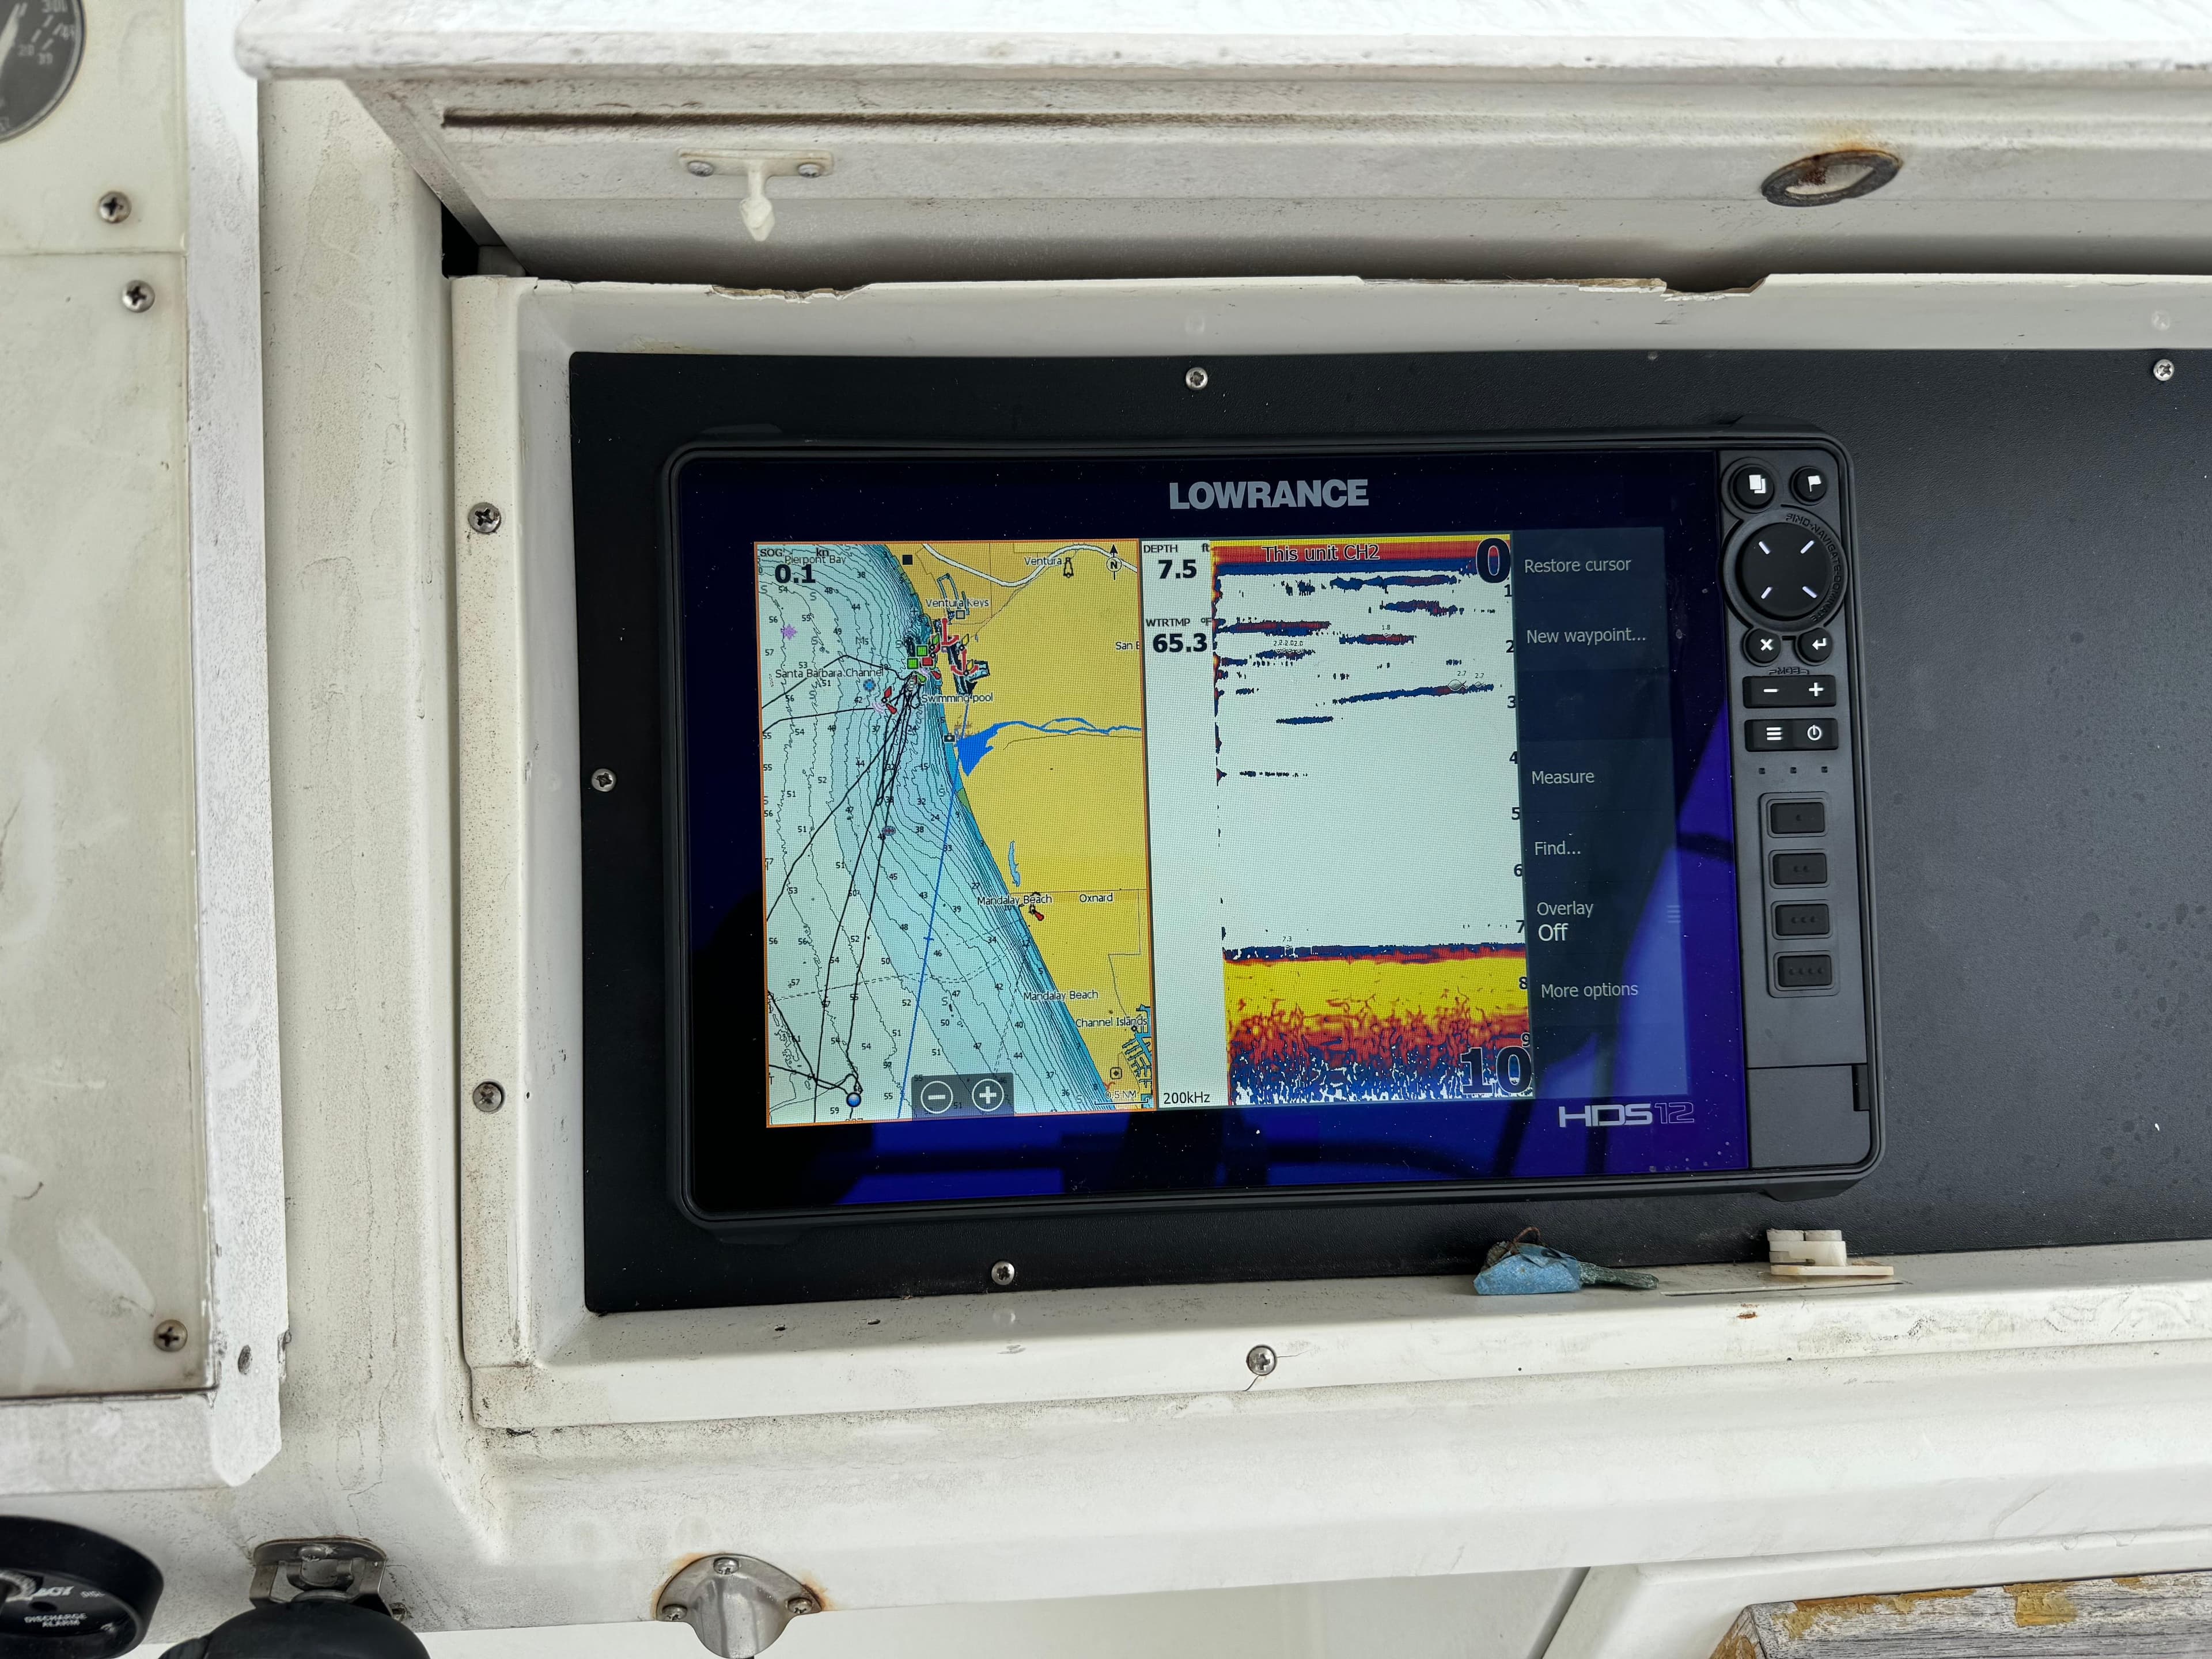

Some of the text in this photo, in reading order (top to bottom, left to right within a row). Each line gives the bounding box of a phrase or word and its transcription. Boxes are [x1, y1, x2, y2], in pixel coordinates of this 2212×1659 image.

[1169, 479, 1369, 509] LOWRANCE
[760, 548, 830, 557] SOG kn
[1143, 543, 1210, 553] DEPTH ft
[1262, 544, 1380, 563] This unit CH2
[785, 555, 846, 565] Pierpont Bay
[1024, 556, 1062, 565] Ventura
[1111, 561, 1118, 569] N
[1476, 537, 1511, 584] 0
[1524, 559, 1631, 573] Restore cursor
[775, 564, 816, 584] 0.1
[1158, 559, 1197, 579] 7.5
[1503, 584, 1512, 597] 1
[926, 599, 989, 608] Ventura Keys
[1146, 618, 1190, 627] WTRTMP
[1153, 633, 1207, 653] 65.3
[1527, 627, 1646, 646] New waypoint...
[1115, 642, 1132, 650] San
[1506, 639, 1514, 653] 2
[775, 668, 884, 679] Santa Barbara Channel
[922, 692, 993, 704] Swimming pool
[1507, 695, 1516, 709] 3
[1509, 751, 1518, 764] 4
[1532, 771, 1595, 785] Measure
[1511, 807, 1520, 820] 5
[1535, 840, 1581, 855] Find...
[1514, 863, 1523, 877] 6
[977, 895, 1052, 907] Mandalay Beach
[1079, 893, 1113, 903] Oxnard
[1537, 901, 1594, 918] Overlay
[1516, 919, 1525, 933] 7
[1538, 923, 1569, 941] Off
[1518, 976, 1528, 990] 8
[1024, 990, 1099, 1002] Mandalay Beach
[1541, 983, 1638, 1001] More options
[1075, 1017, 1147, 1028] Channel Islands
[1521, 1032, 1530, 1047] 9
[1460, 1046, 1532, 1094] 10
[1123, 1090, 1137, 1099] NM
[1164, 1091, 1210, 1104] 200kHz
